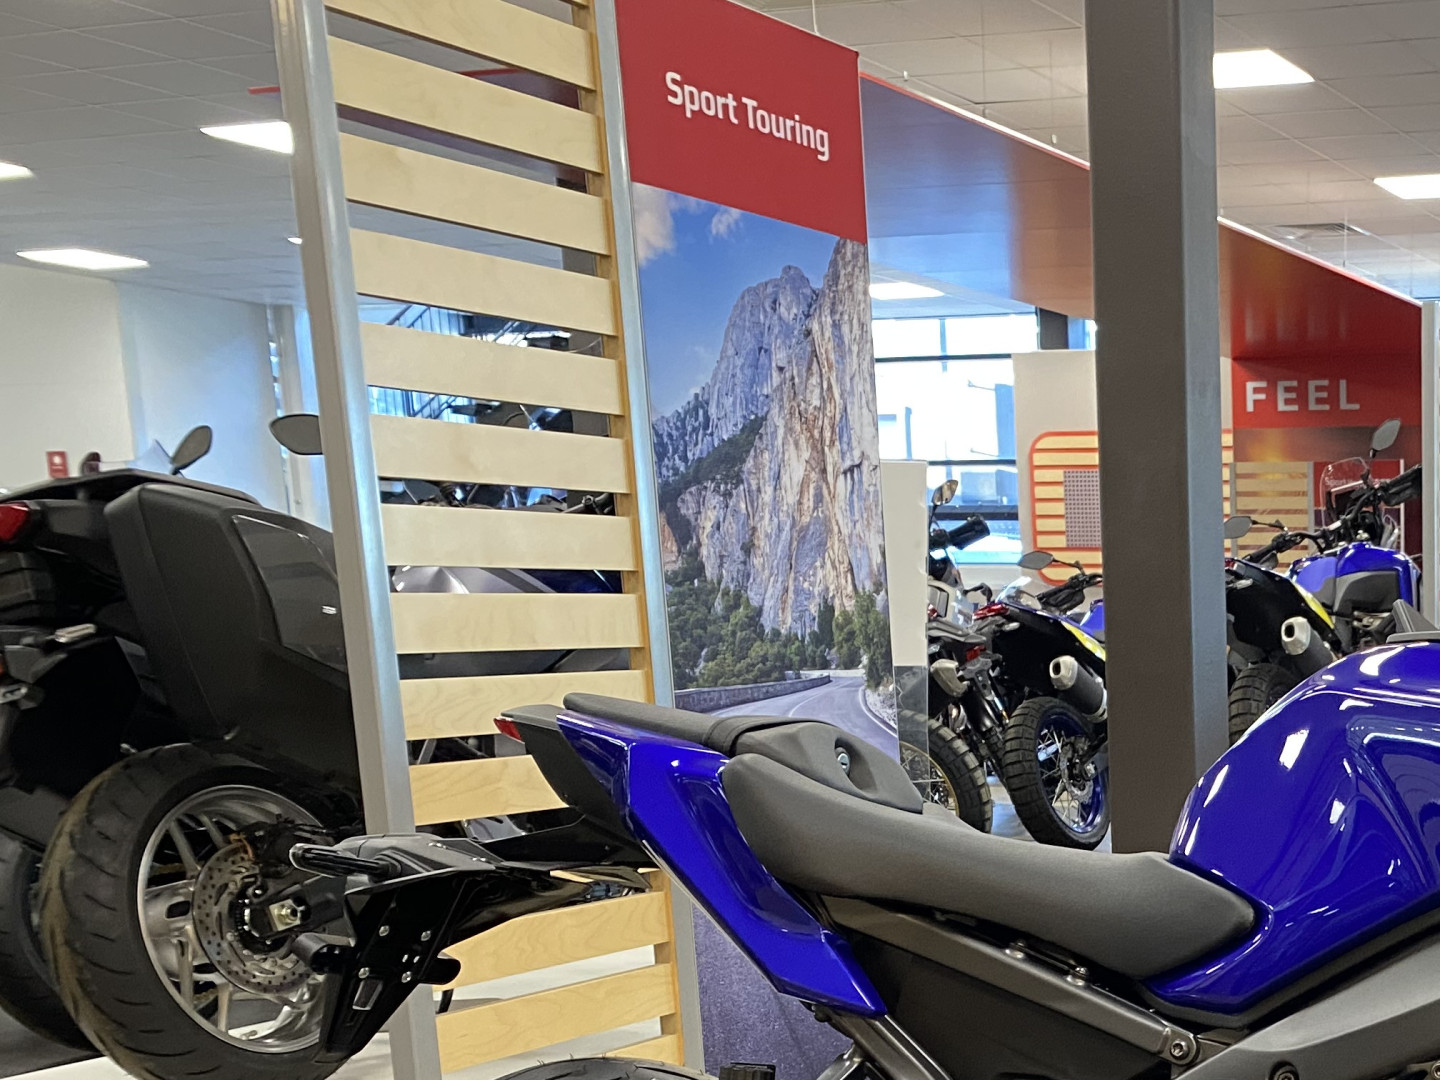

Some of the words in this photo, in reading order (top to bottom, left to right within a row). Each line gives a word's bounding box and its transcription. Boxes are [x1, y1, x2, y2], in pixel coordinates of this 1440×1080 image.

[665, 71, 739, 118] Sport
[741, 96, 830, 162] Touring
[1245, 379, 1361, 412] FEEL
